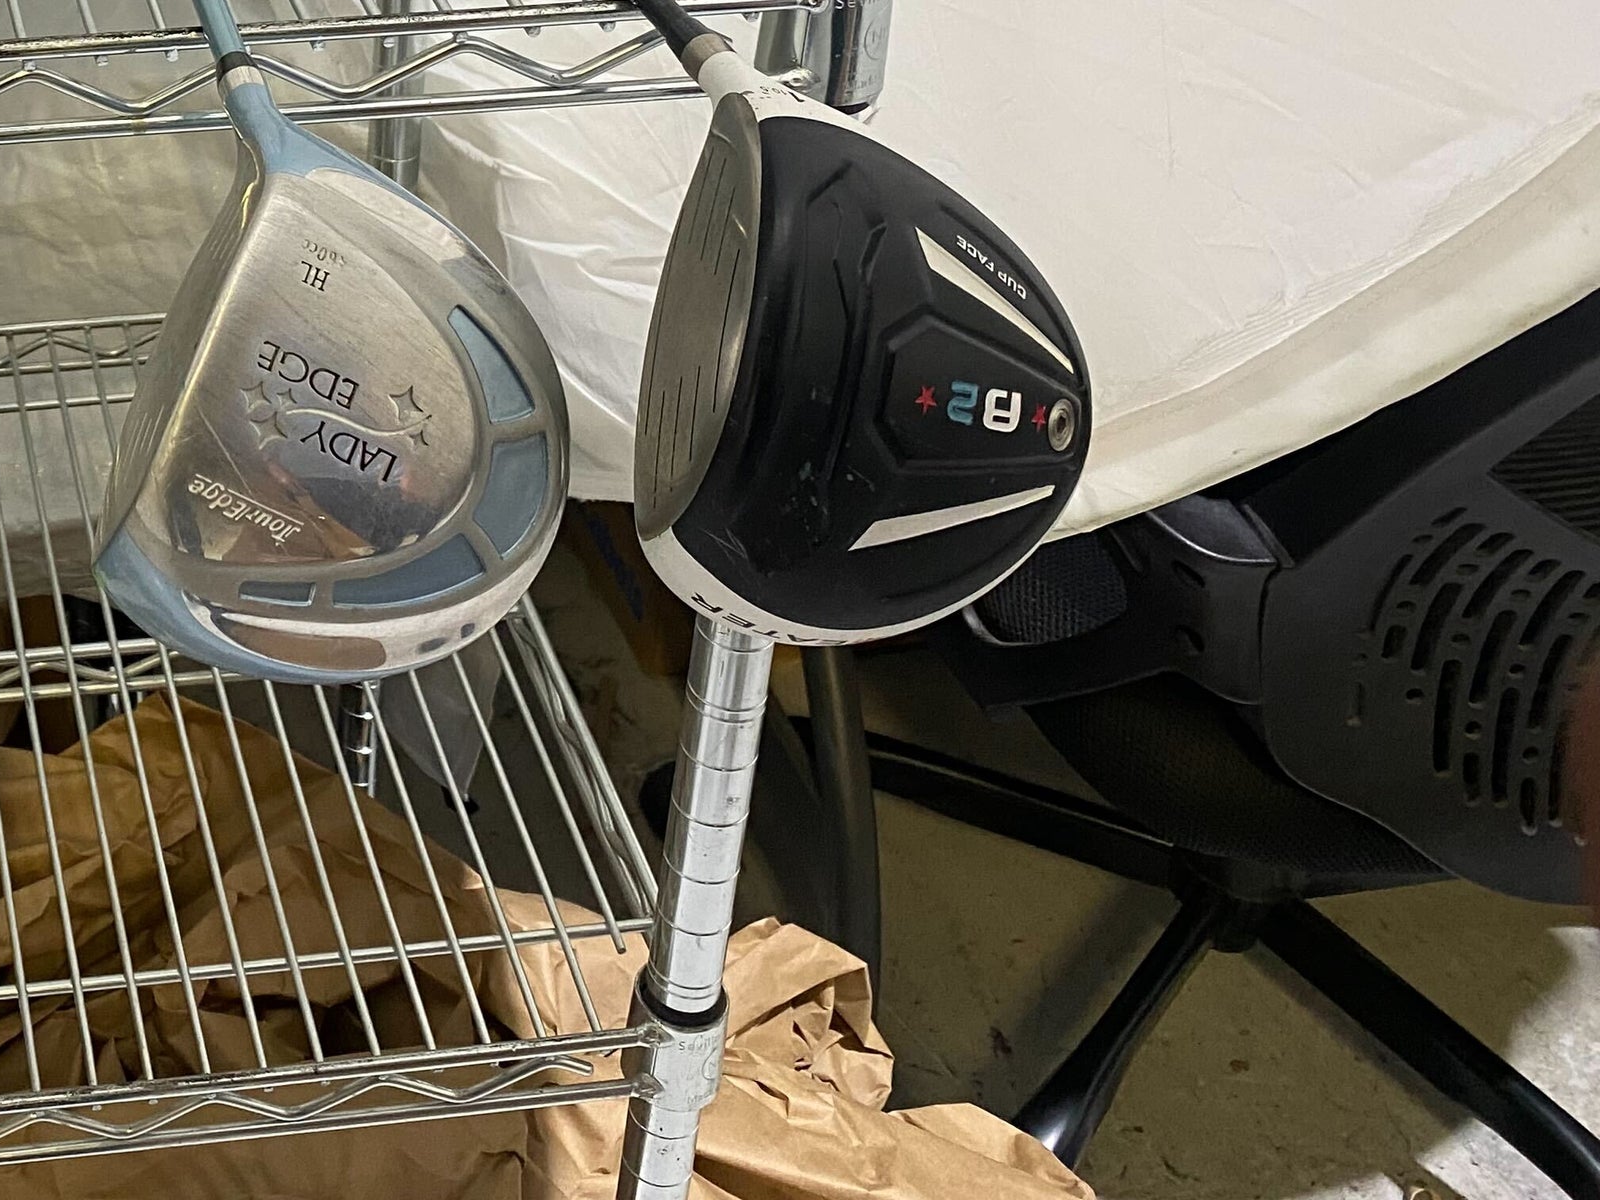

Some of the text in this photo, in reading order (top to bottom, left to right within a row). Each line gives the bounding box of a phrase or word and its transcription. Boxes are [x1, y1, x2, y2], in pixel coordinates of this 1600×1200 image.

[300, 259, 331, 293] HL
[955, 233, 1028, 300] CUP FACE
[257, 339, 361, 410] EDGE
[301, 419, 399, 483] LADY
